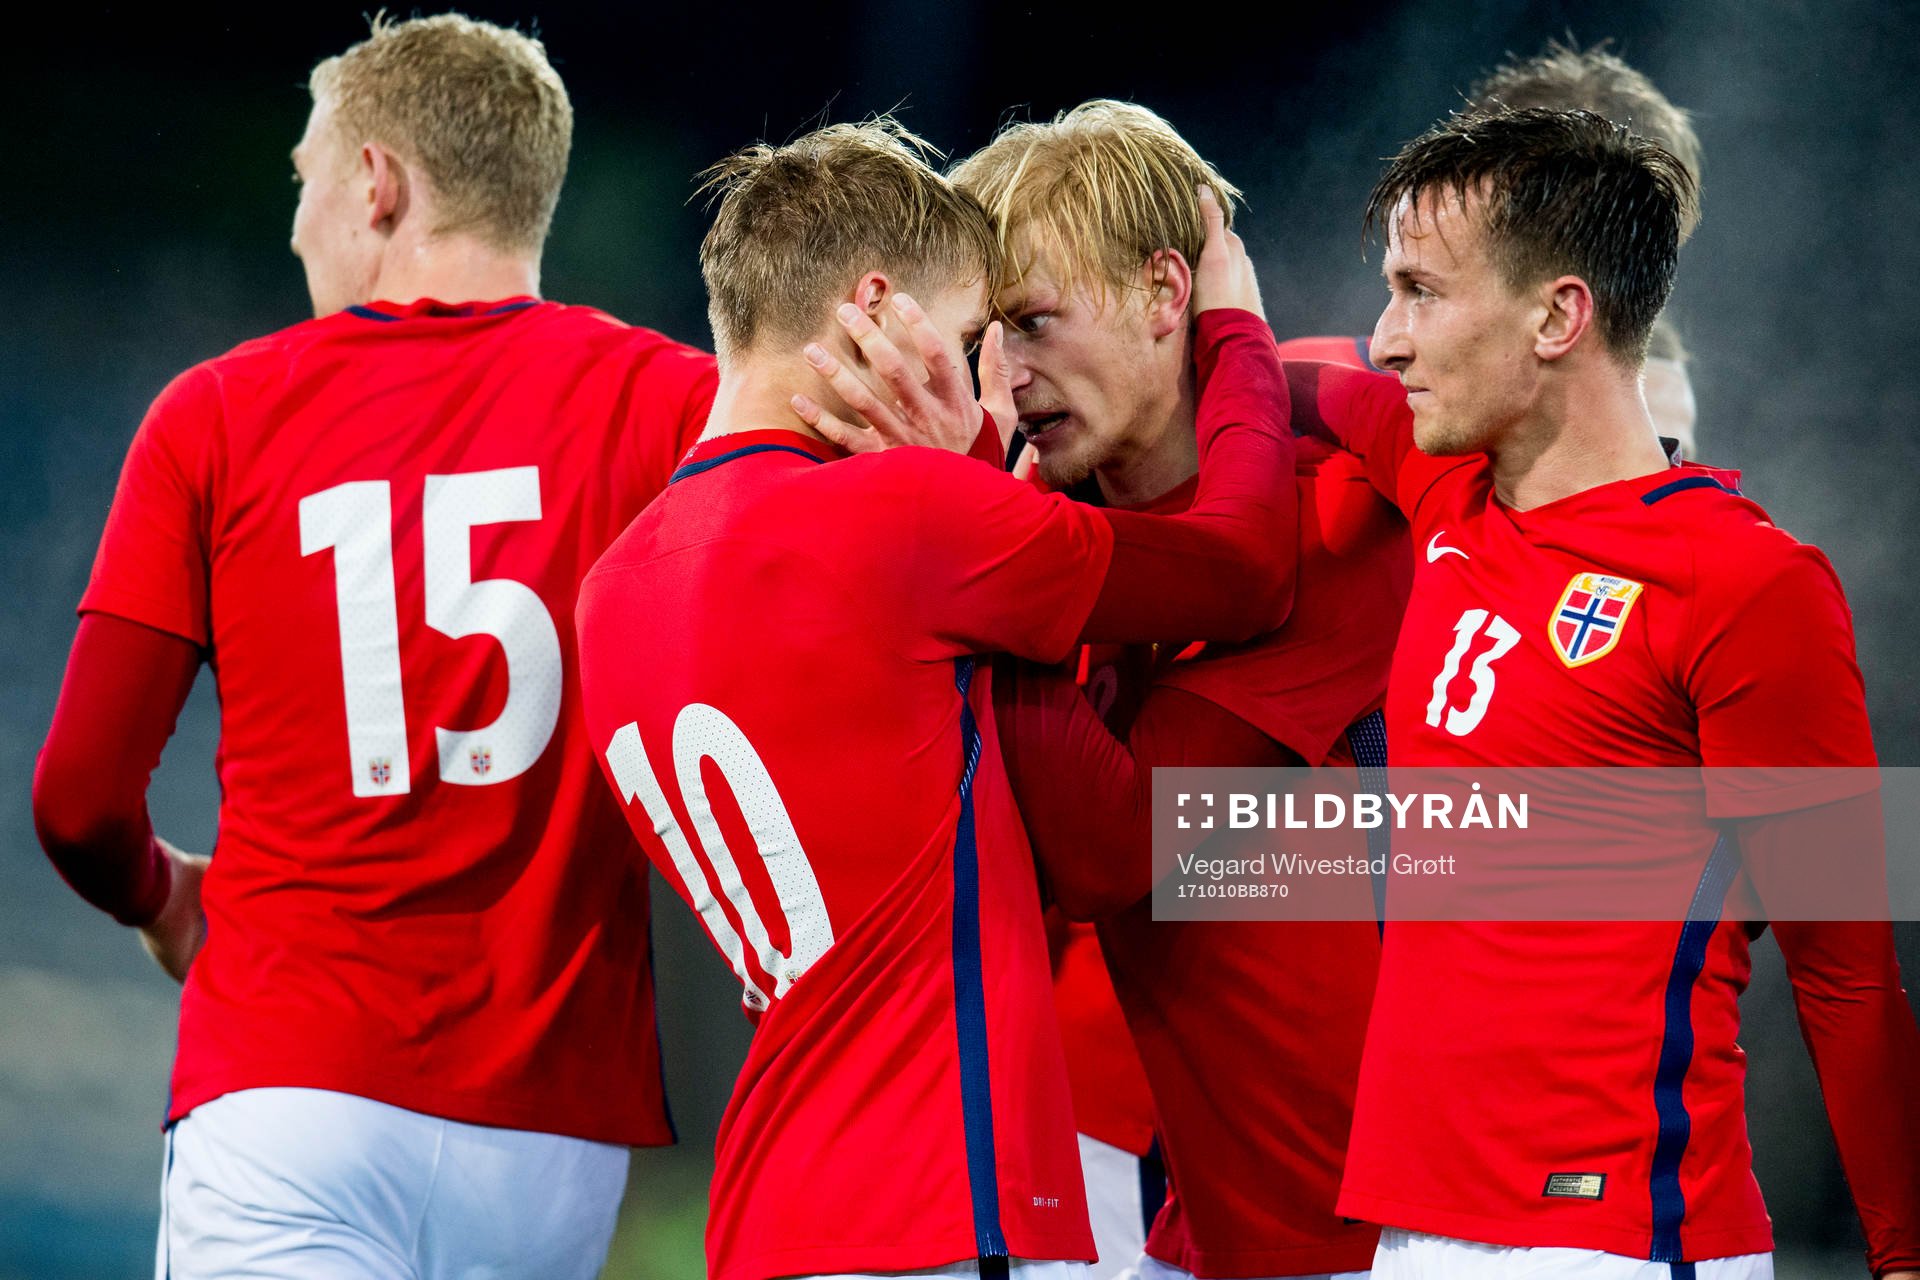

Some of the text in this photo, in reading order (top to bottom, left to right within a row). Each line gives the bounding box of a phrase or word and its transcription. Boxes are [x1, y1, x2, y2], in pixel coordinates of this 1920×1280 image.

[298, 465, 563, 798] 15
[1425, 608, 1522, 737] 13
[605, 702, 836, 1013] 10
